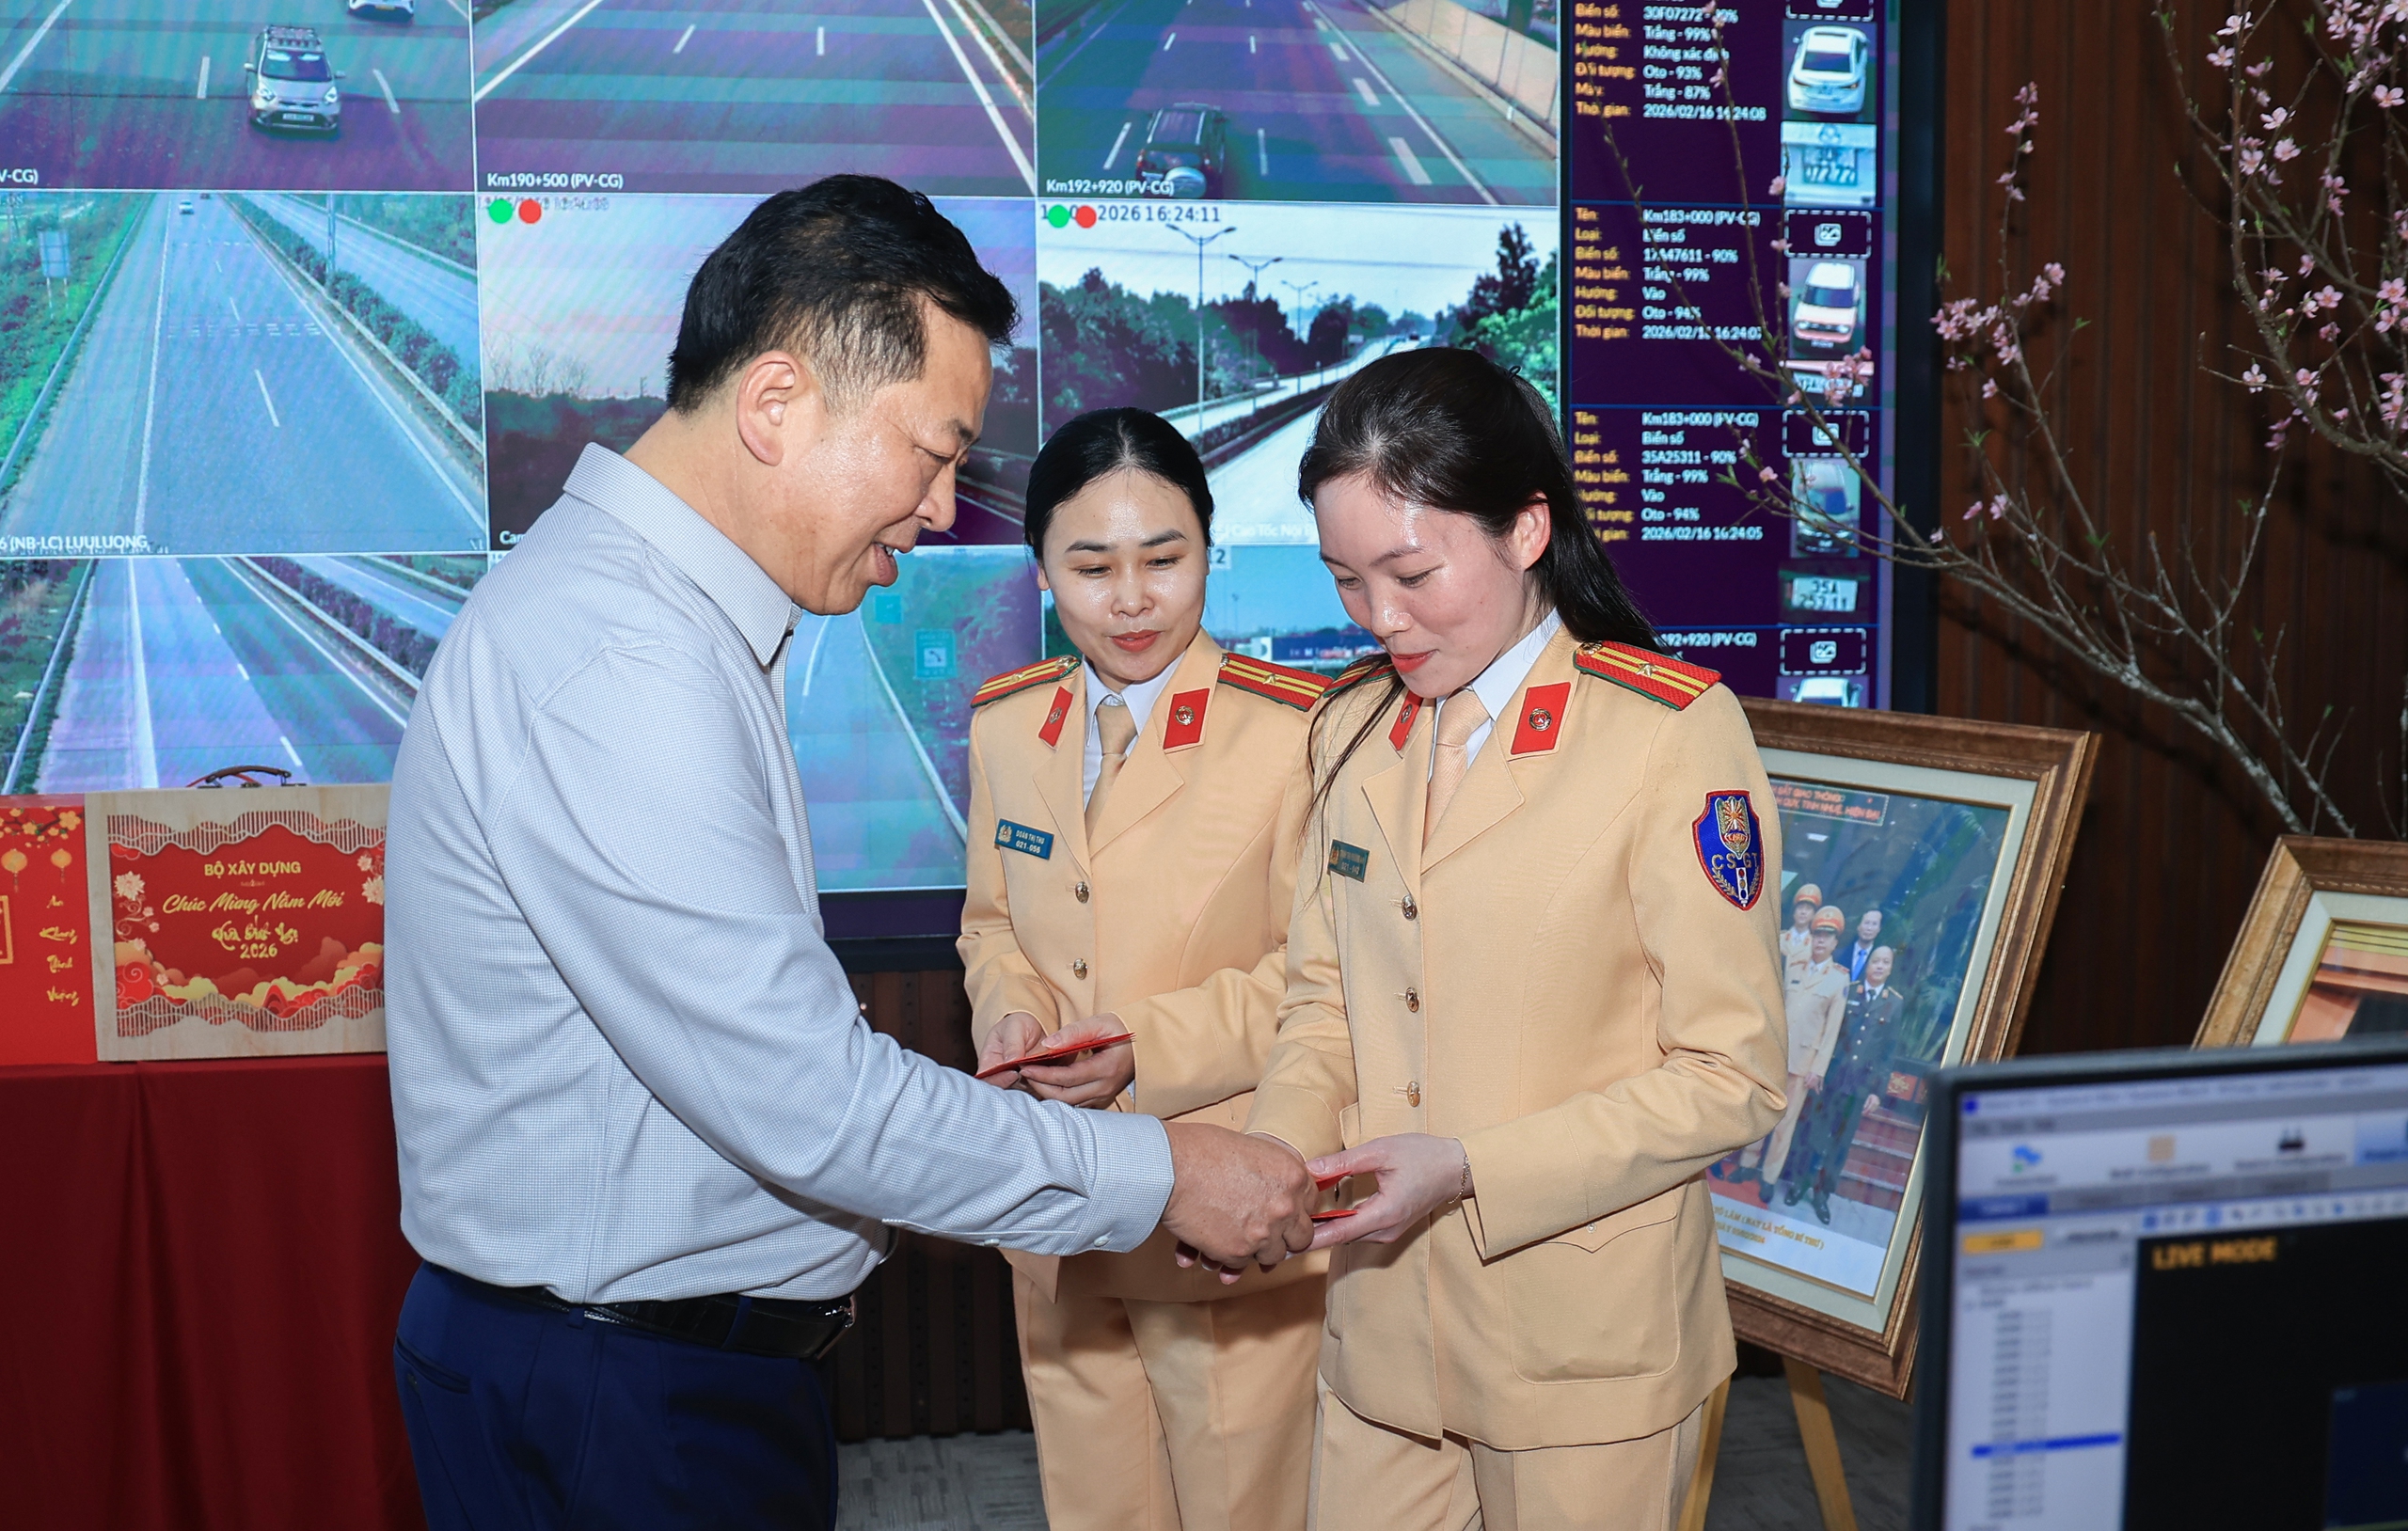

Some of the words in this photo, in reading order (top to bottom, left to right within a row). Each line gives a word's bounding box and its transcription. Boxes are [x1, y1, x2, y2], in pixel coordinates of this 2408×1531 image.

[1576, 24, 1601, 38] Màu
[1685, 27, 1711, 42] 99%
[1643, 45, 1681, 62] Không
[1675, 66, 1703, 81] 93%
[1684, 86, 1711, 101] 87%
[1643, 103, 1714, 120] 2026/02/16
[487, 173, 569, 188] Km190+500
[570, 173, 624, 189] (PV-CG)
[1046, 179, 1123, 194] Km192+920
[1125, 180, 1175, 197] (PV-CG)
[1147, 206, 1221, 222] 16:24:11
[1643, 209, 1714, 225] Km183+000
[1712, 249, 1738, 264] 90%
[1576, 266, 1601, 280] Màu
[1683, 268, 1710, 282] 99%
[1642, 286, 1667, 301] Vào
[1641, 412, 1712, 427] Km183+000
[1641, 431, 1669, 446] Biển
[1641, 450, 1702, 466] 35A25311
[1710, 451, 1736, 466] 90%
[1575, 469, 1601, 483] Màu
[1682, 469, 1709, 484] 99%
[1641, 488, 1666, 503] Vào
[1673, 508, 1700, 523] 94%
[1641, 527, 1712, 542] 2026/02/16
[10, 536, 63, 552] (NB-LC)
[66, 534, 148, 550] LUULUONG
[1712, 631, 1757, 648] (PV-CG)
[204, 860, 225, 879] BỘ
[228, 860, 257, 876] XÂY
[259, 860, 302, 878] DỰNG
[163, 893, 207, 914] Chúc
[209, 892, 261, 916] Mừng
[262, 890, 306, 911] Năm
[240, 942, 278, 959] 2026
